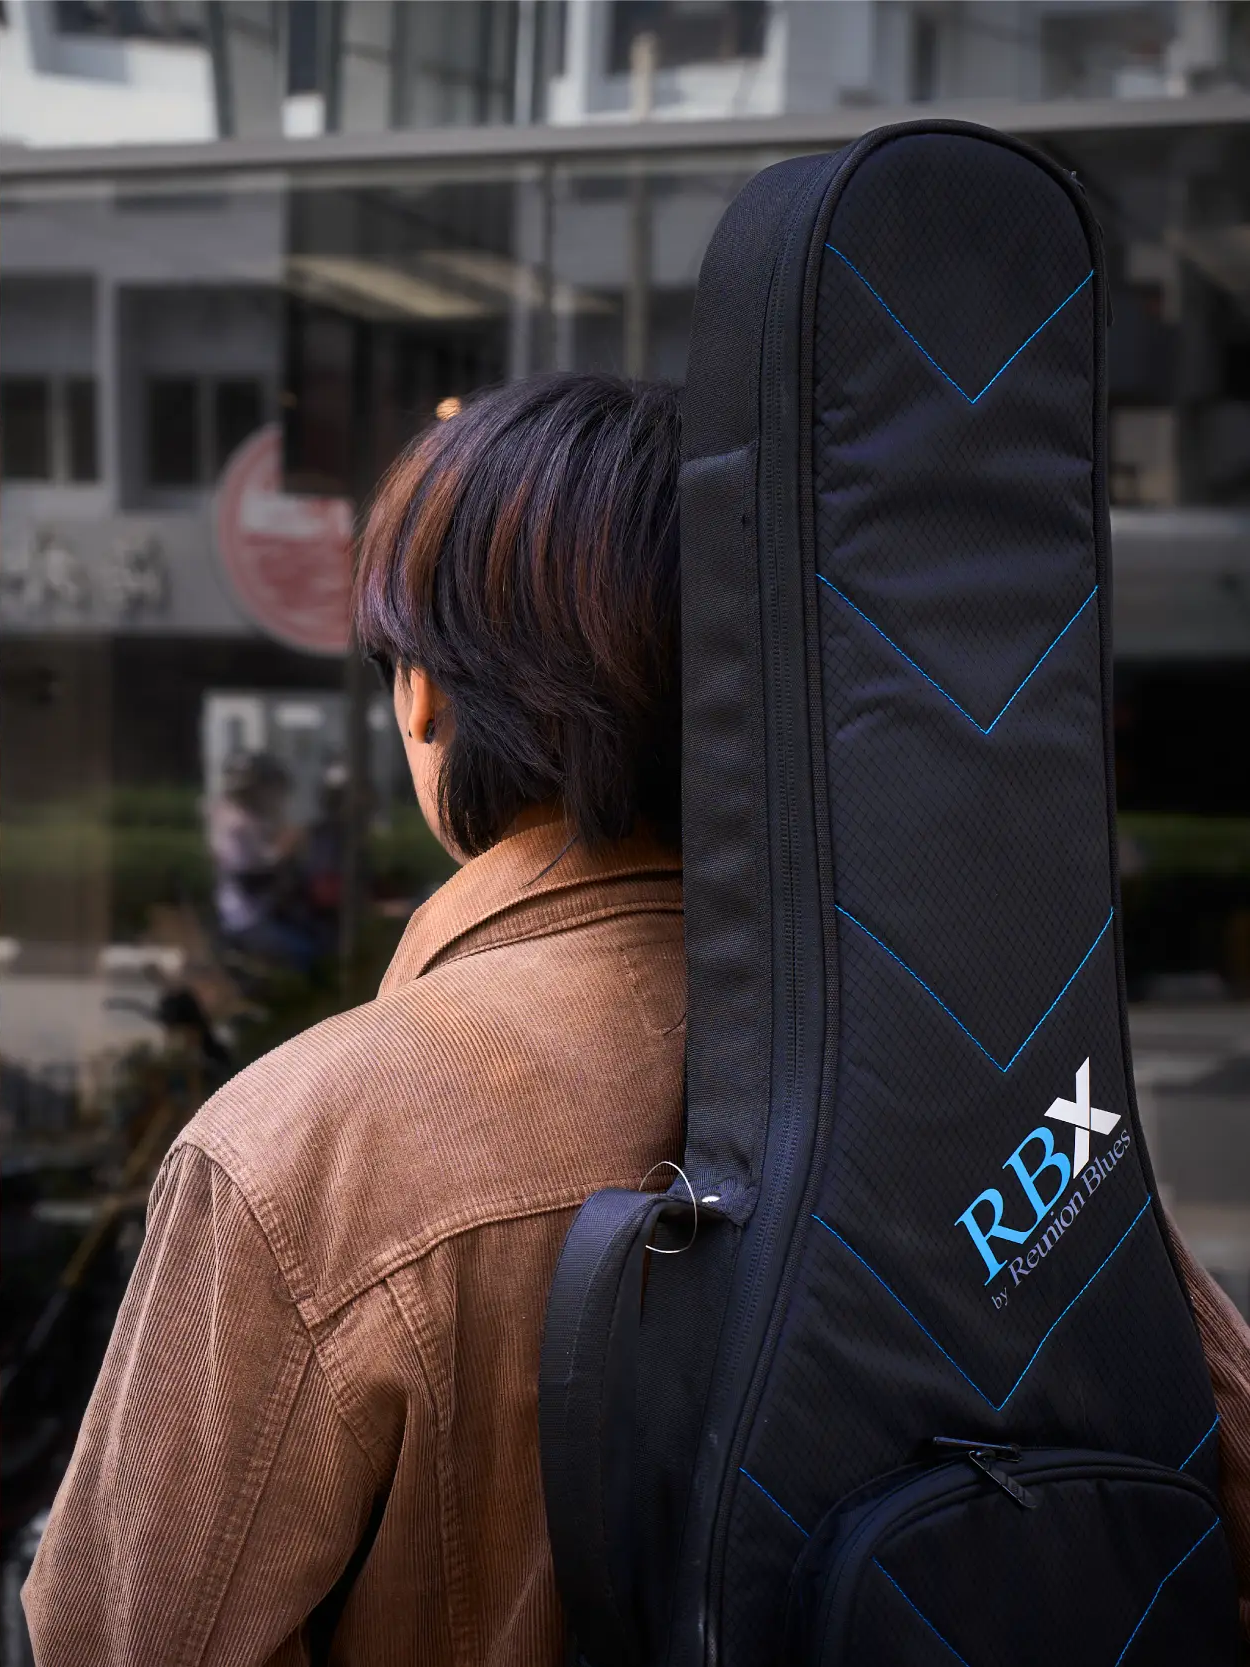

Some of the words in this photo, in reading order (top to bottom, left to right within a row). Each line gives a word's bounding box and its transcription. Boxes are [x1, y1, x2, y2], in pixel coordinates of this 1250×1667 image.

[954, 1056, 1122, 1286] RBX
[991, 1287, 1008, 1310] by
[1006, 1191, 1086, 1288] Reunion
[1080, 1128, 1132, 1197] Blues
